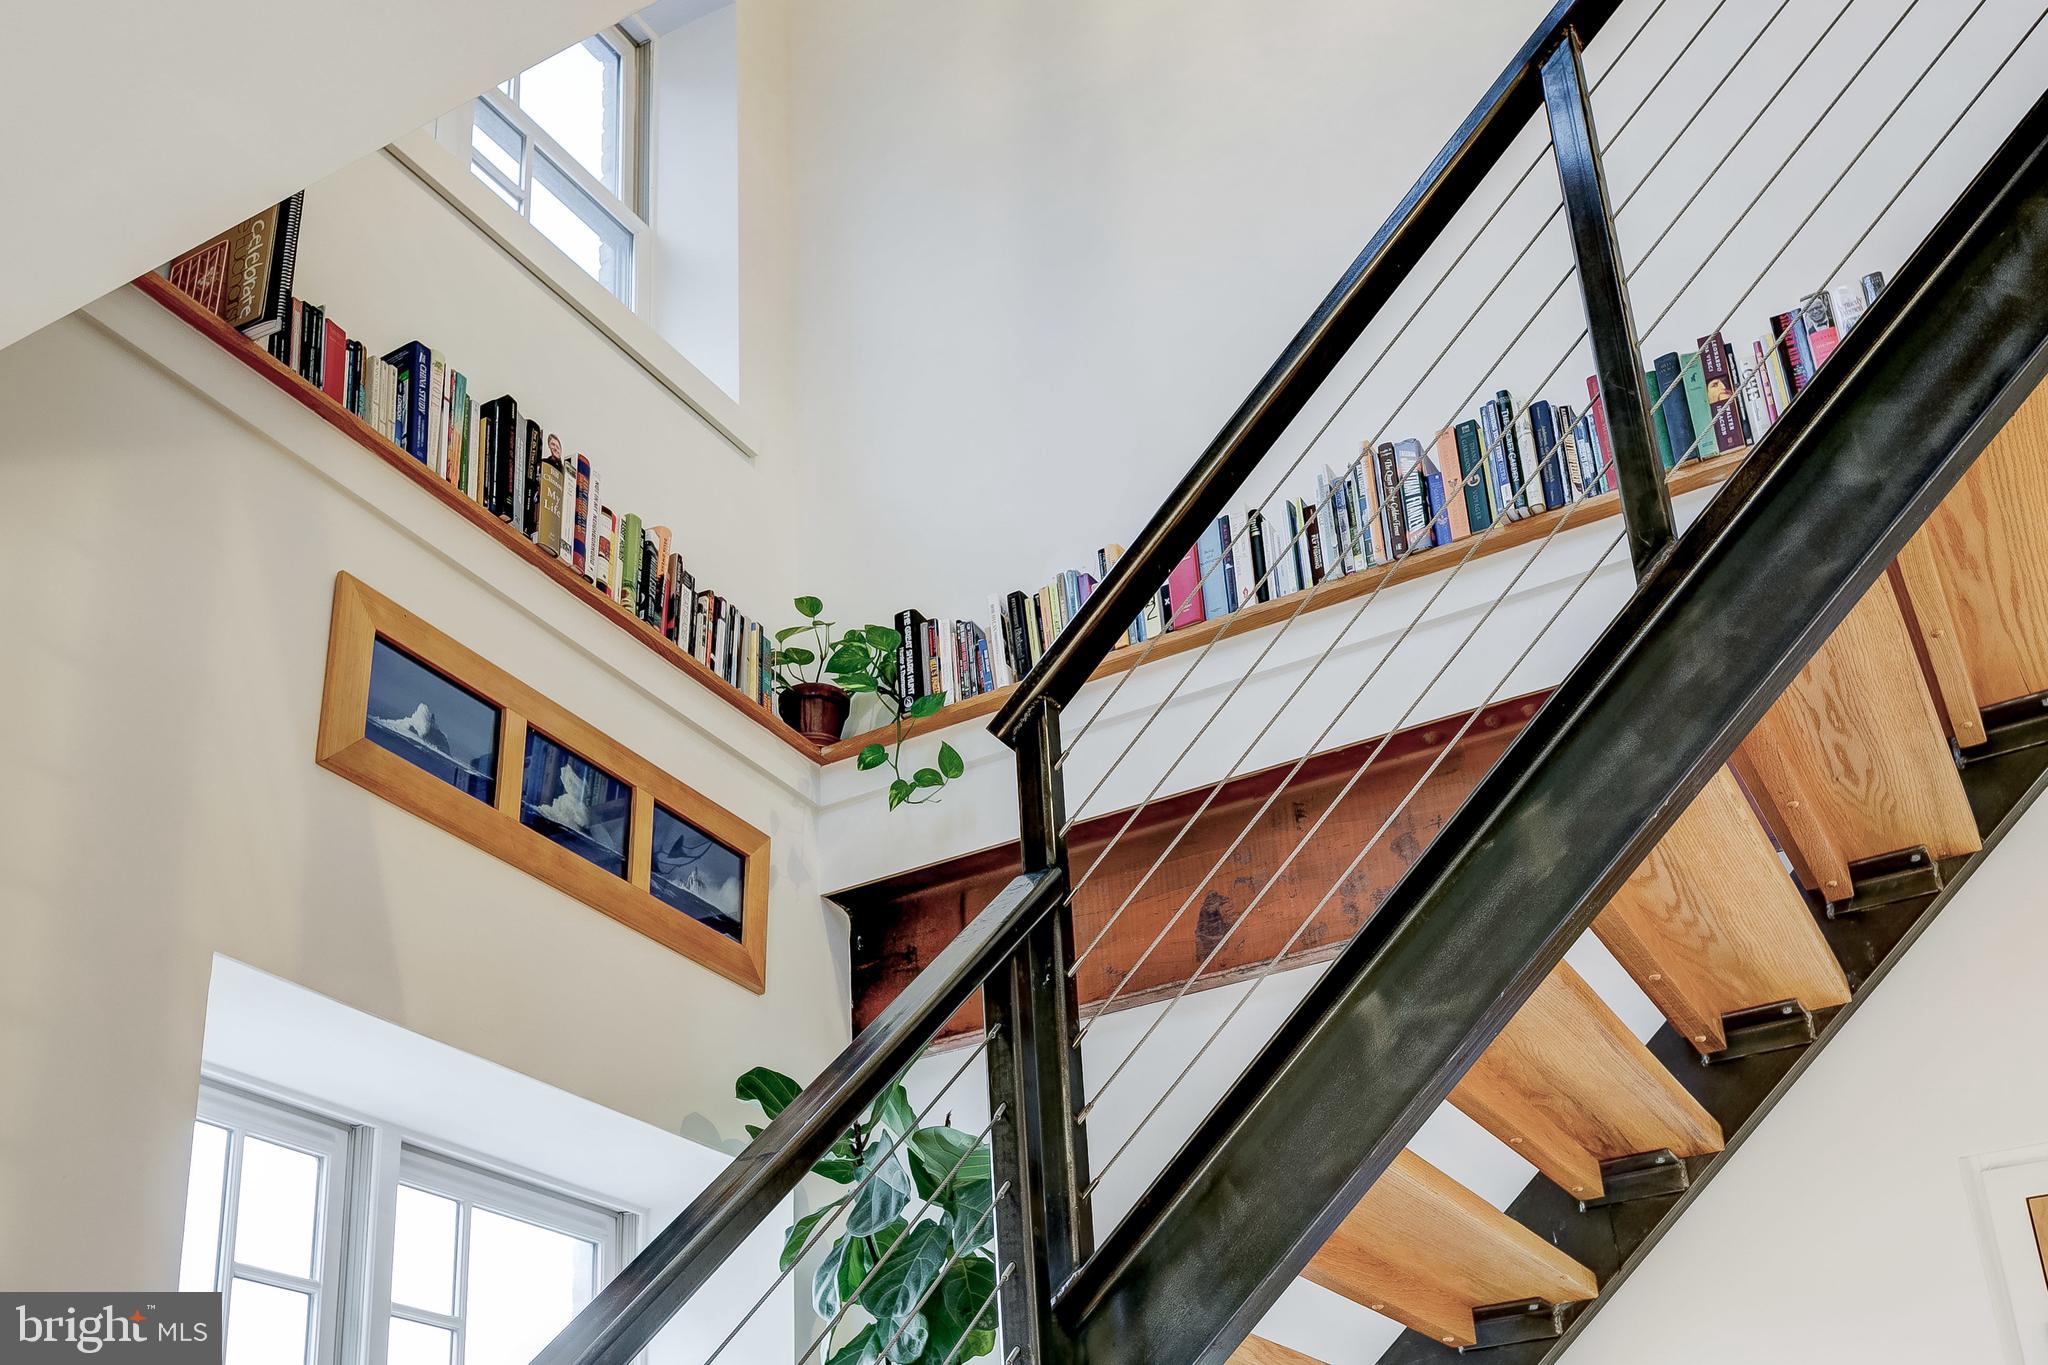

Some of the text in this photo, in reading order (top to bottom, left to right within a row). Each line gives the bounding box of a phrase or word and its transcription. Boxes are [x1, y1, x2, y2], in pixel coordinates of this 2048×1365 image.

[240, 219, 264, 319] Celebrate
[1706, 356, 1714, 373] VINCI
[1712, 340, 1721, 372] LEONARDO
[419, 364, 427, 388] CHINA
[418, 388, 426, 415] STUDY
[1383, 458, 1393, 470] The
[1508, 451, 1519, 482] GARDEN
[544, 499, 561, 519] Life
[547, 487, 560, 505] My
[1472, 490, 1482, 521] VOYAGER
[1405, 496, 1426, 533] FRANZEN
[588, 512, 598, 566] NEIGHBORHOOD
[903, 611, 915, 695] THE GREAT SHARK HUNT
